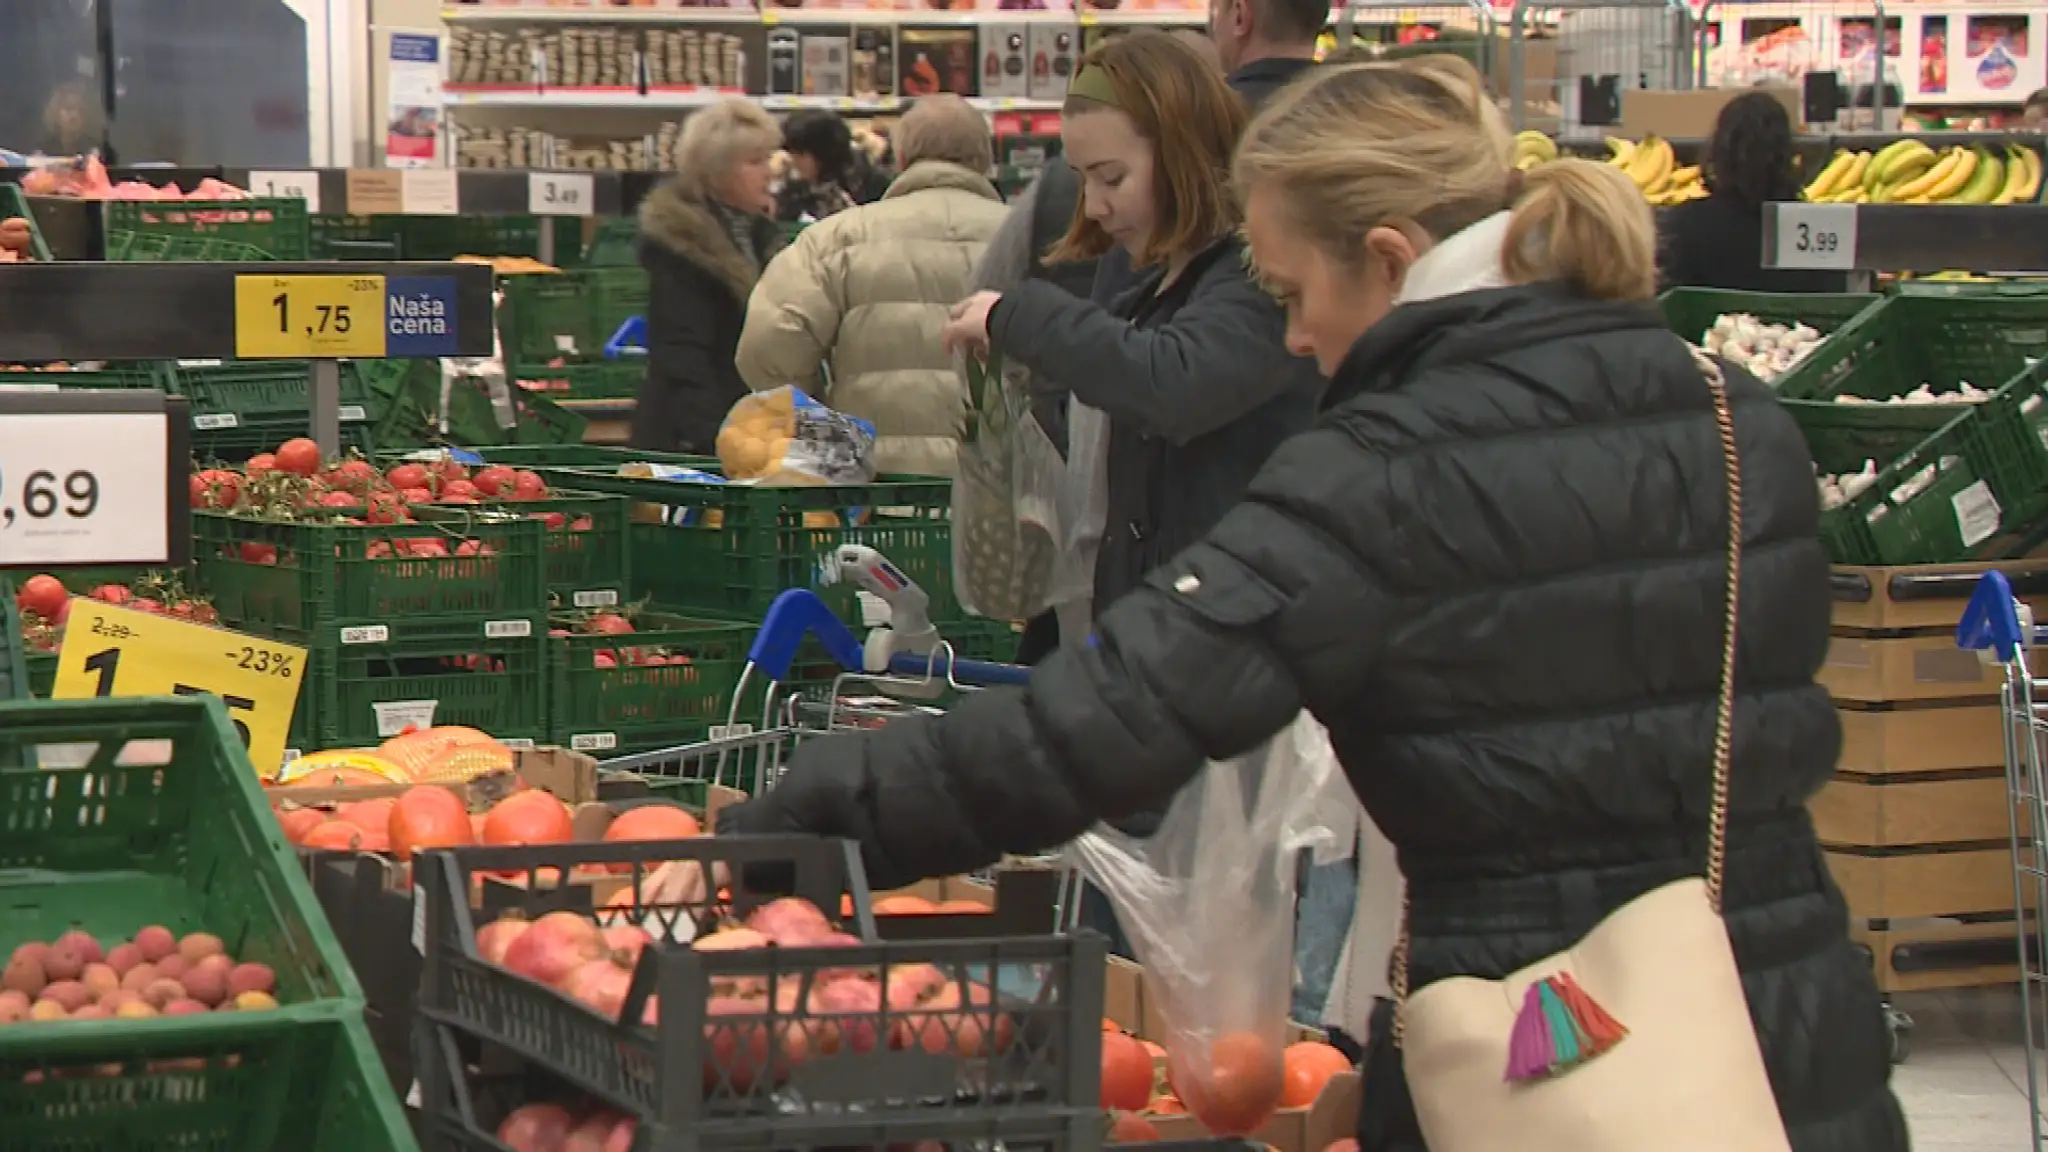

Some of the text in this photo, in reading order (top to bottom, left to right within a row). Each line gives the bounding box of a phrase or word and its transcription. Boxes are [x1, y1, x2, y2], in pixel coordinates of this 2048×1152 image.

[1796, 222, 1838, 252] 3,99
[389, 292, 445, 316] Naša
[0, 466, 99, 528] ,69
[225, 646, 293, 679] -23%
